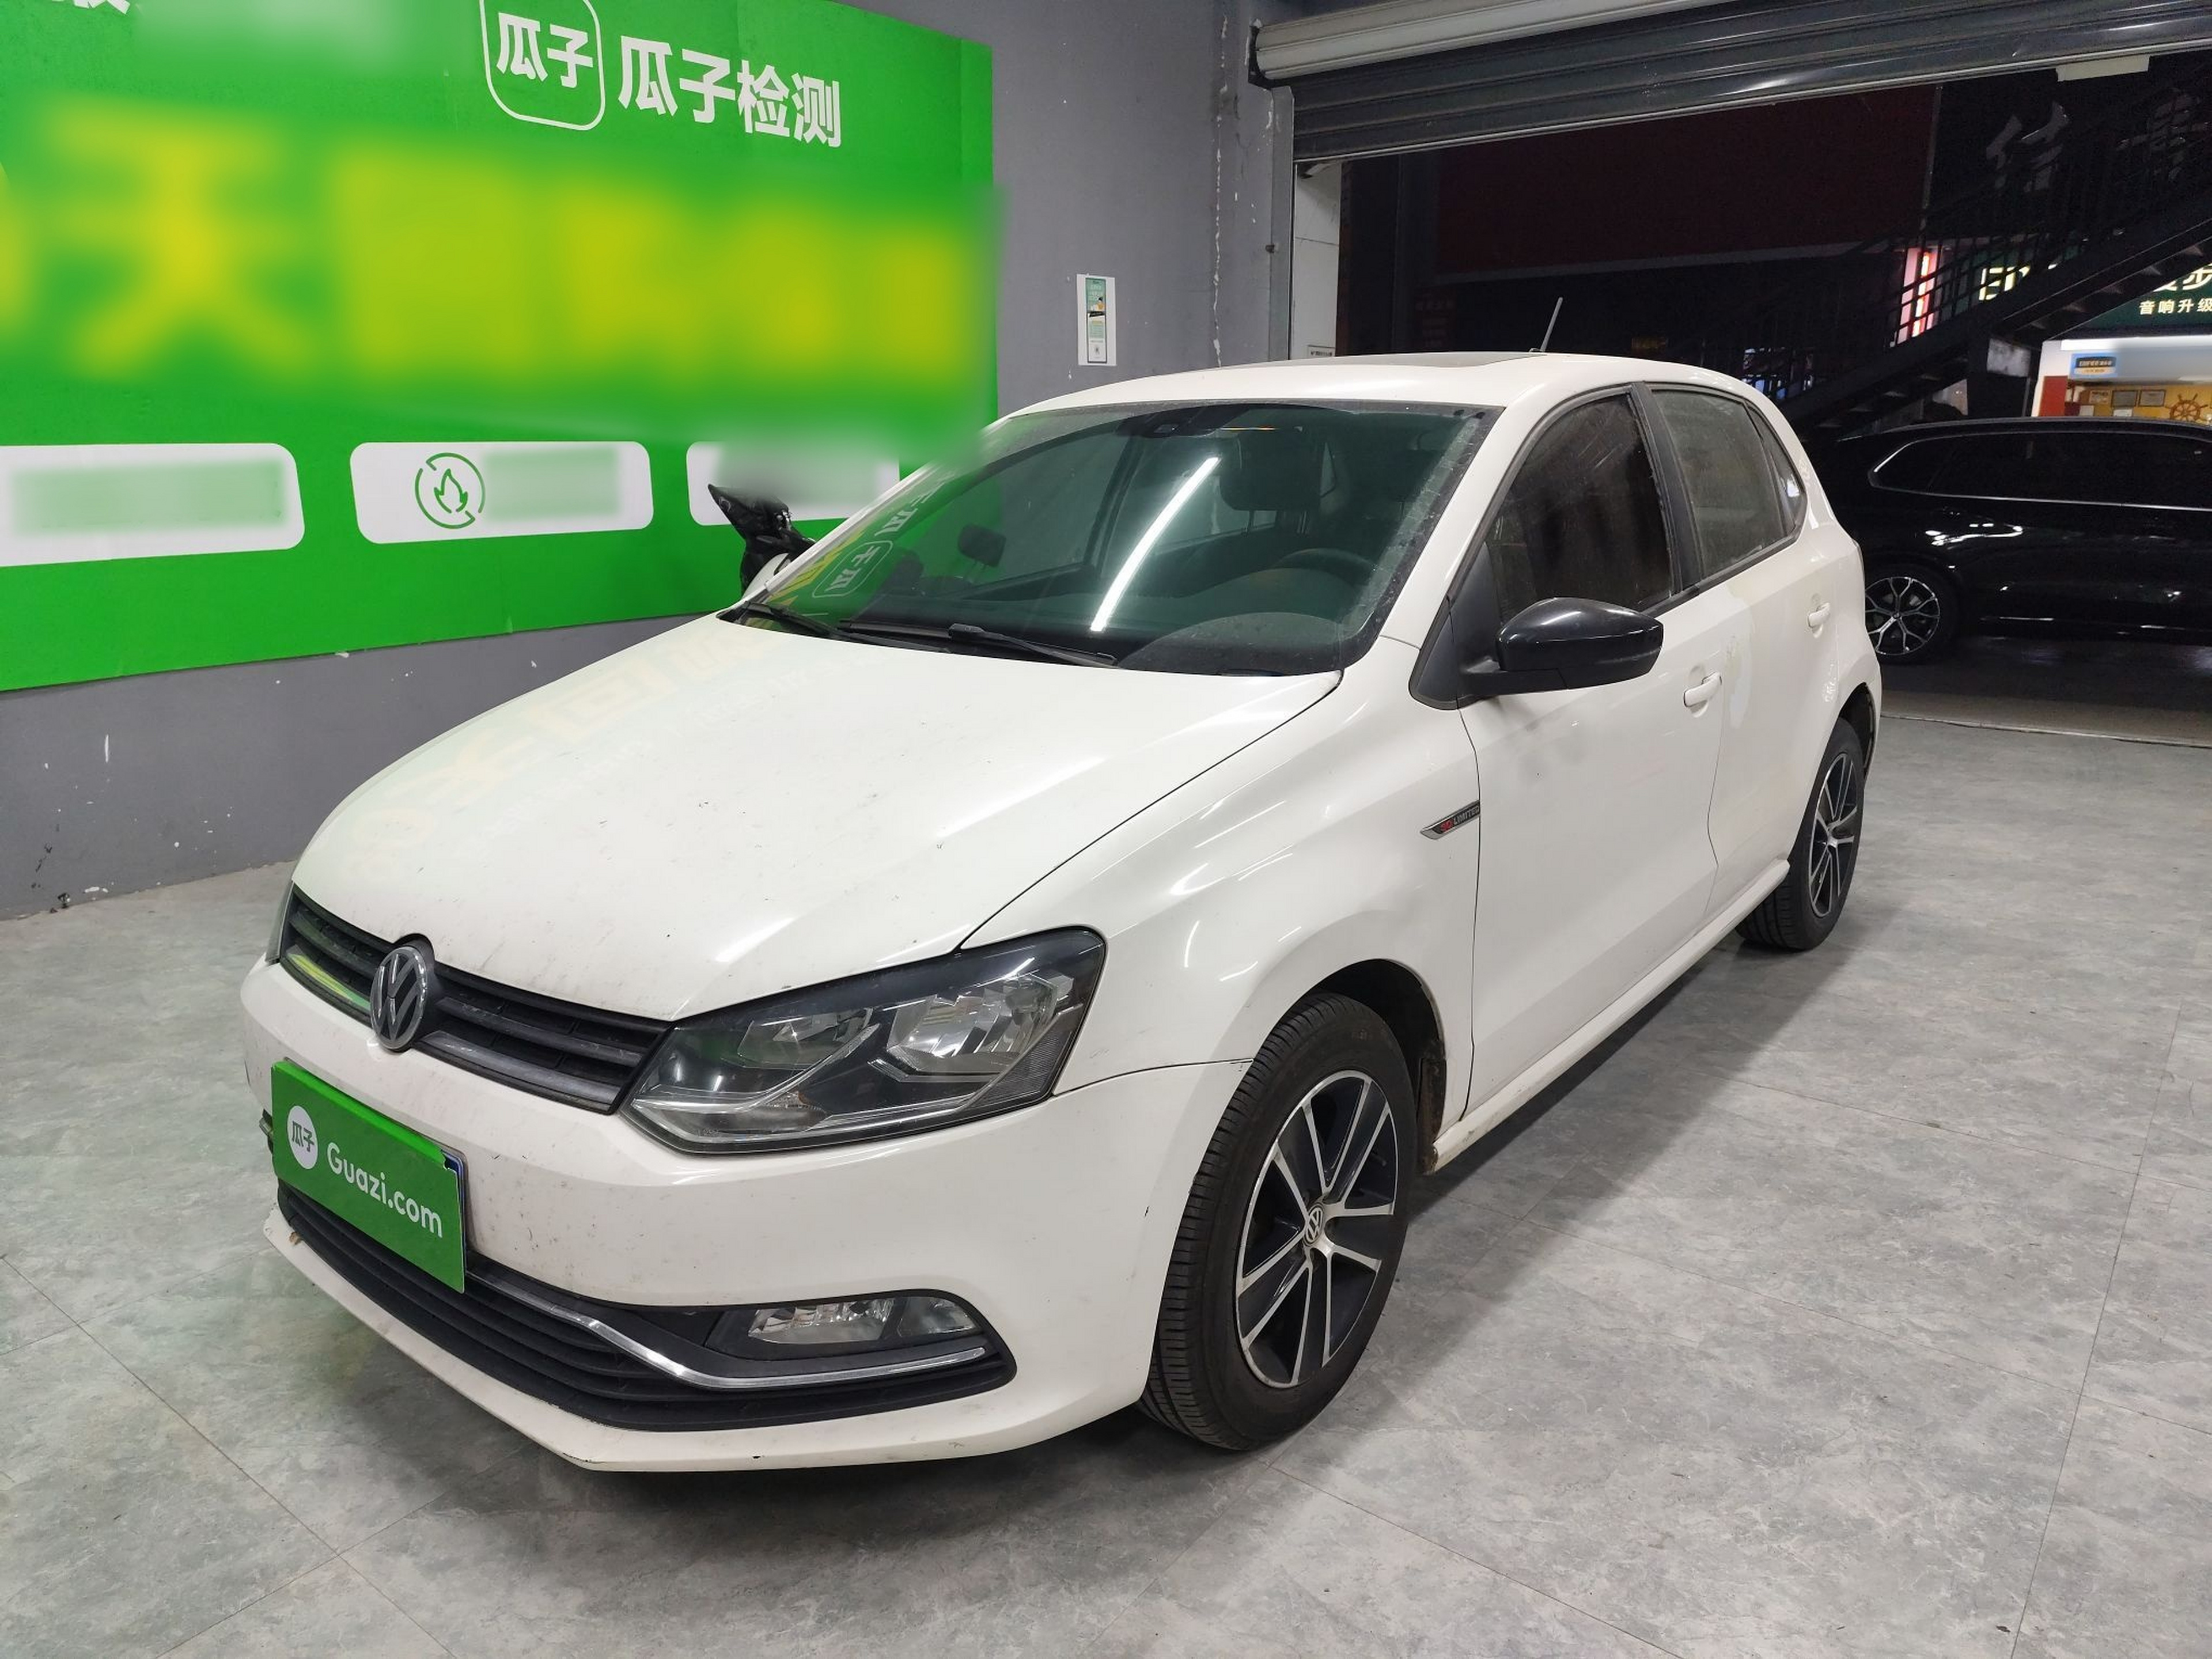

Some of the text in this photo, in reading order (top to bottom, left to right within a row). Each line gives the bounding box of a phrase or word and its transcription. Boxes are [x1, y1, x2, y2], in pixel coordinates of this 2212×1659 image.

[496, 12, 594, 88] 瓜子
[618, 35, 842, 147] 瓜子检测
[2139, 298, 2212, 315] 音响升级
[291, 1120, 315, 1152] 瓜子
[327, 1142, 444, 1238] Guazi.com
